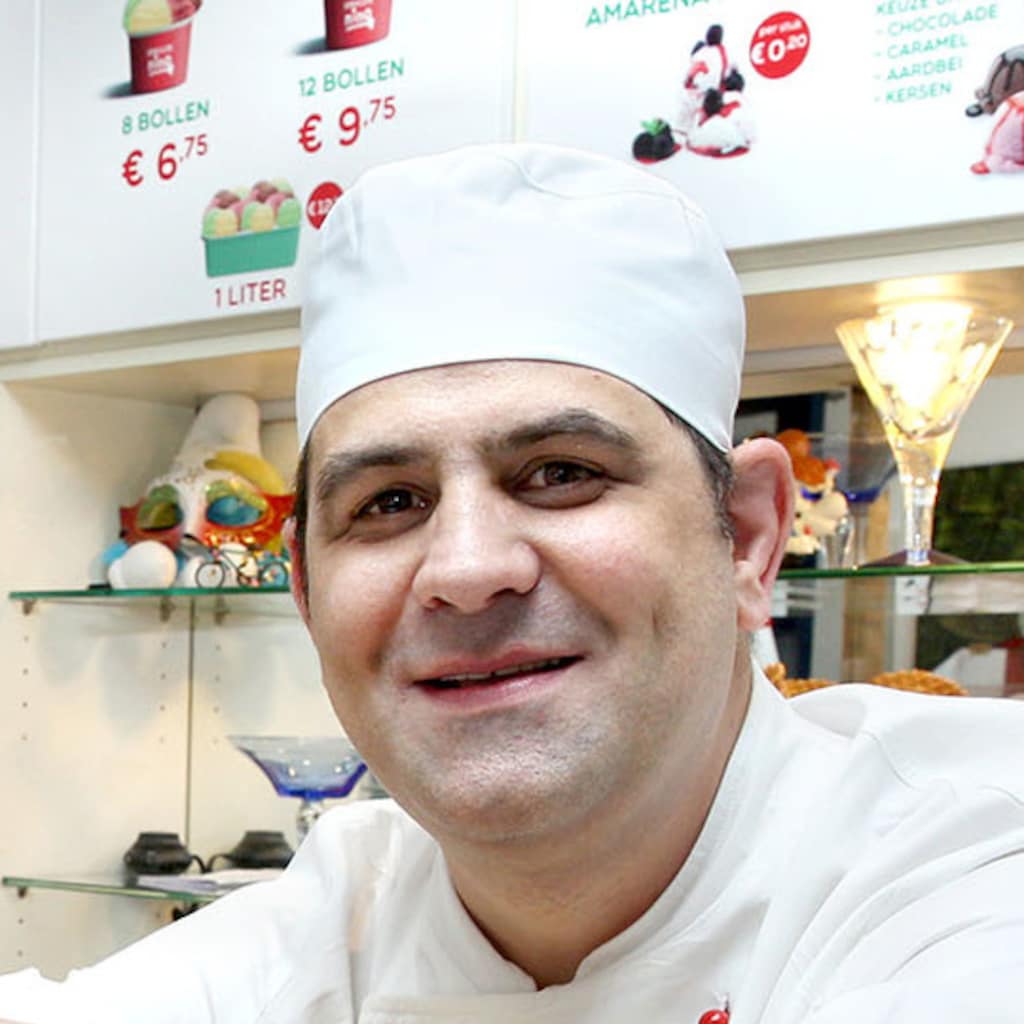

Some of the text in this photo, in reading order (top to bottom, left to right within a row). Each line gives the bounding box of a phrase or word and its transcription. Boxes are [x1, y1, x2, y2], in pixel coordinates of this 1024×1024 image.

[888, 4, 998, 36] CHOCOLADE
[887, 33, 968, 59] CARAMEL
[299, 58, 405, 97] 12 BOLLEN
[887, 56, 962, 80] AARDBEI
[886, 80, 952, 103] KERSEN
[122, 100, 211, 135] 8 BOLLEN
[298, 113, 322, 153] €
[122, 149, 144, 187] €
[215, 278, 287, 308] 1 LITER
